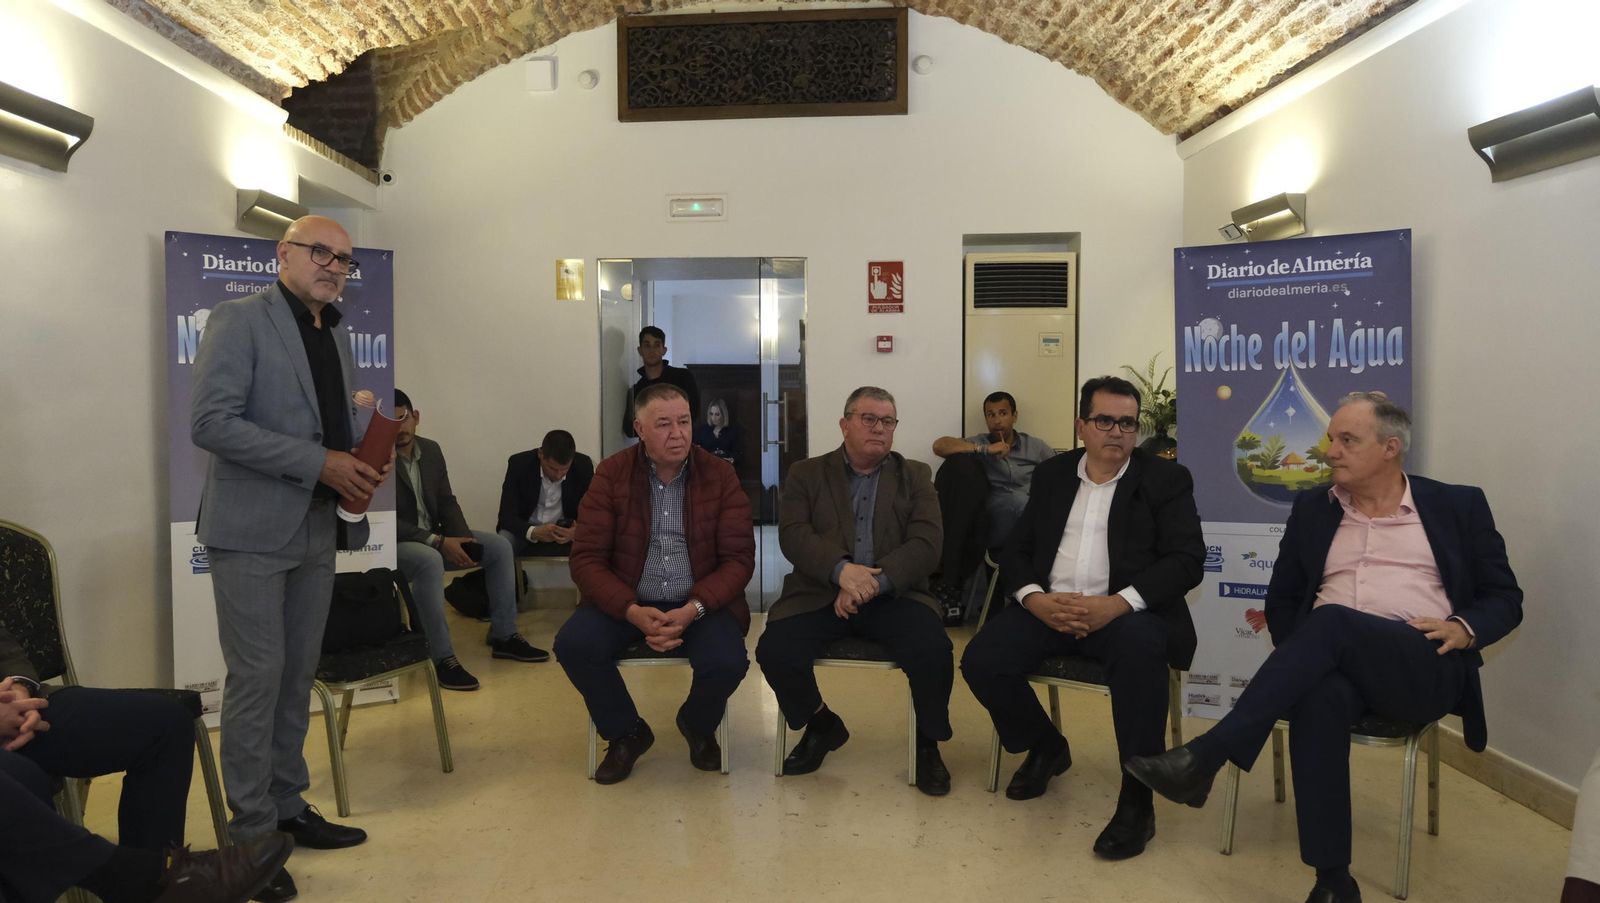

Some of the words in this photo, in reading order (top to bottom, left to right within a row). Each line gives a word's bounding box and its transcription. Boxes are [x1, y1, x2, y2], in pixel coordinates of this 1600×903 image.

[202, 254, 264, 273] Diario
[1207, 259, 1265, 280] Diario
[1266, 258, 1290, 275] de
[1291, 252, 1373, 273] Almería
[1227, 282, 1348, 299] diariodealmeria.es
[1184, 324, 1263, 373] Noche
[1273, 319, 1317, 370] del
[1328, 318, 1405, 374] Agua
[1249, 559, 1274, 571] aqu
